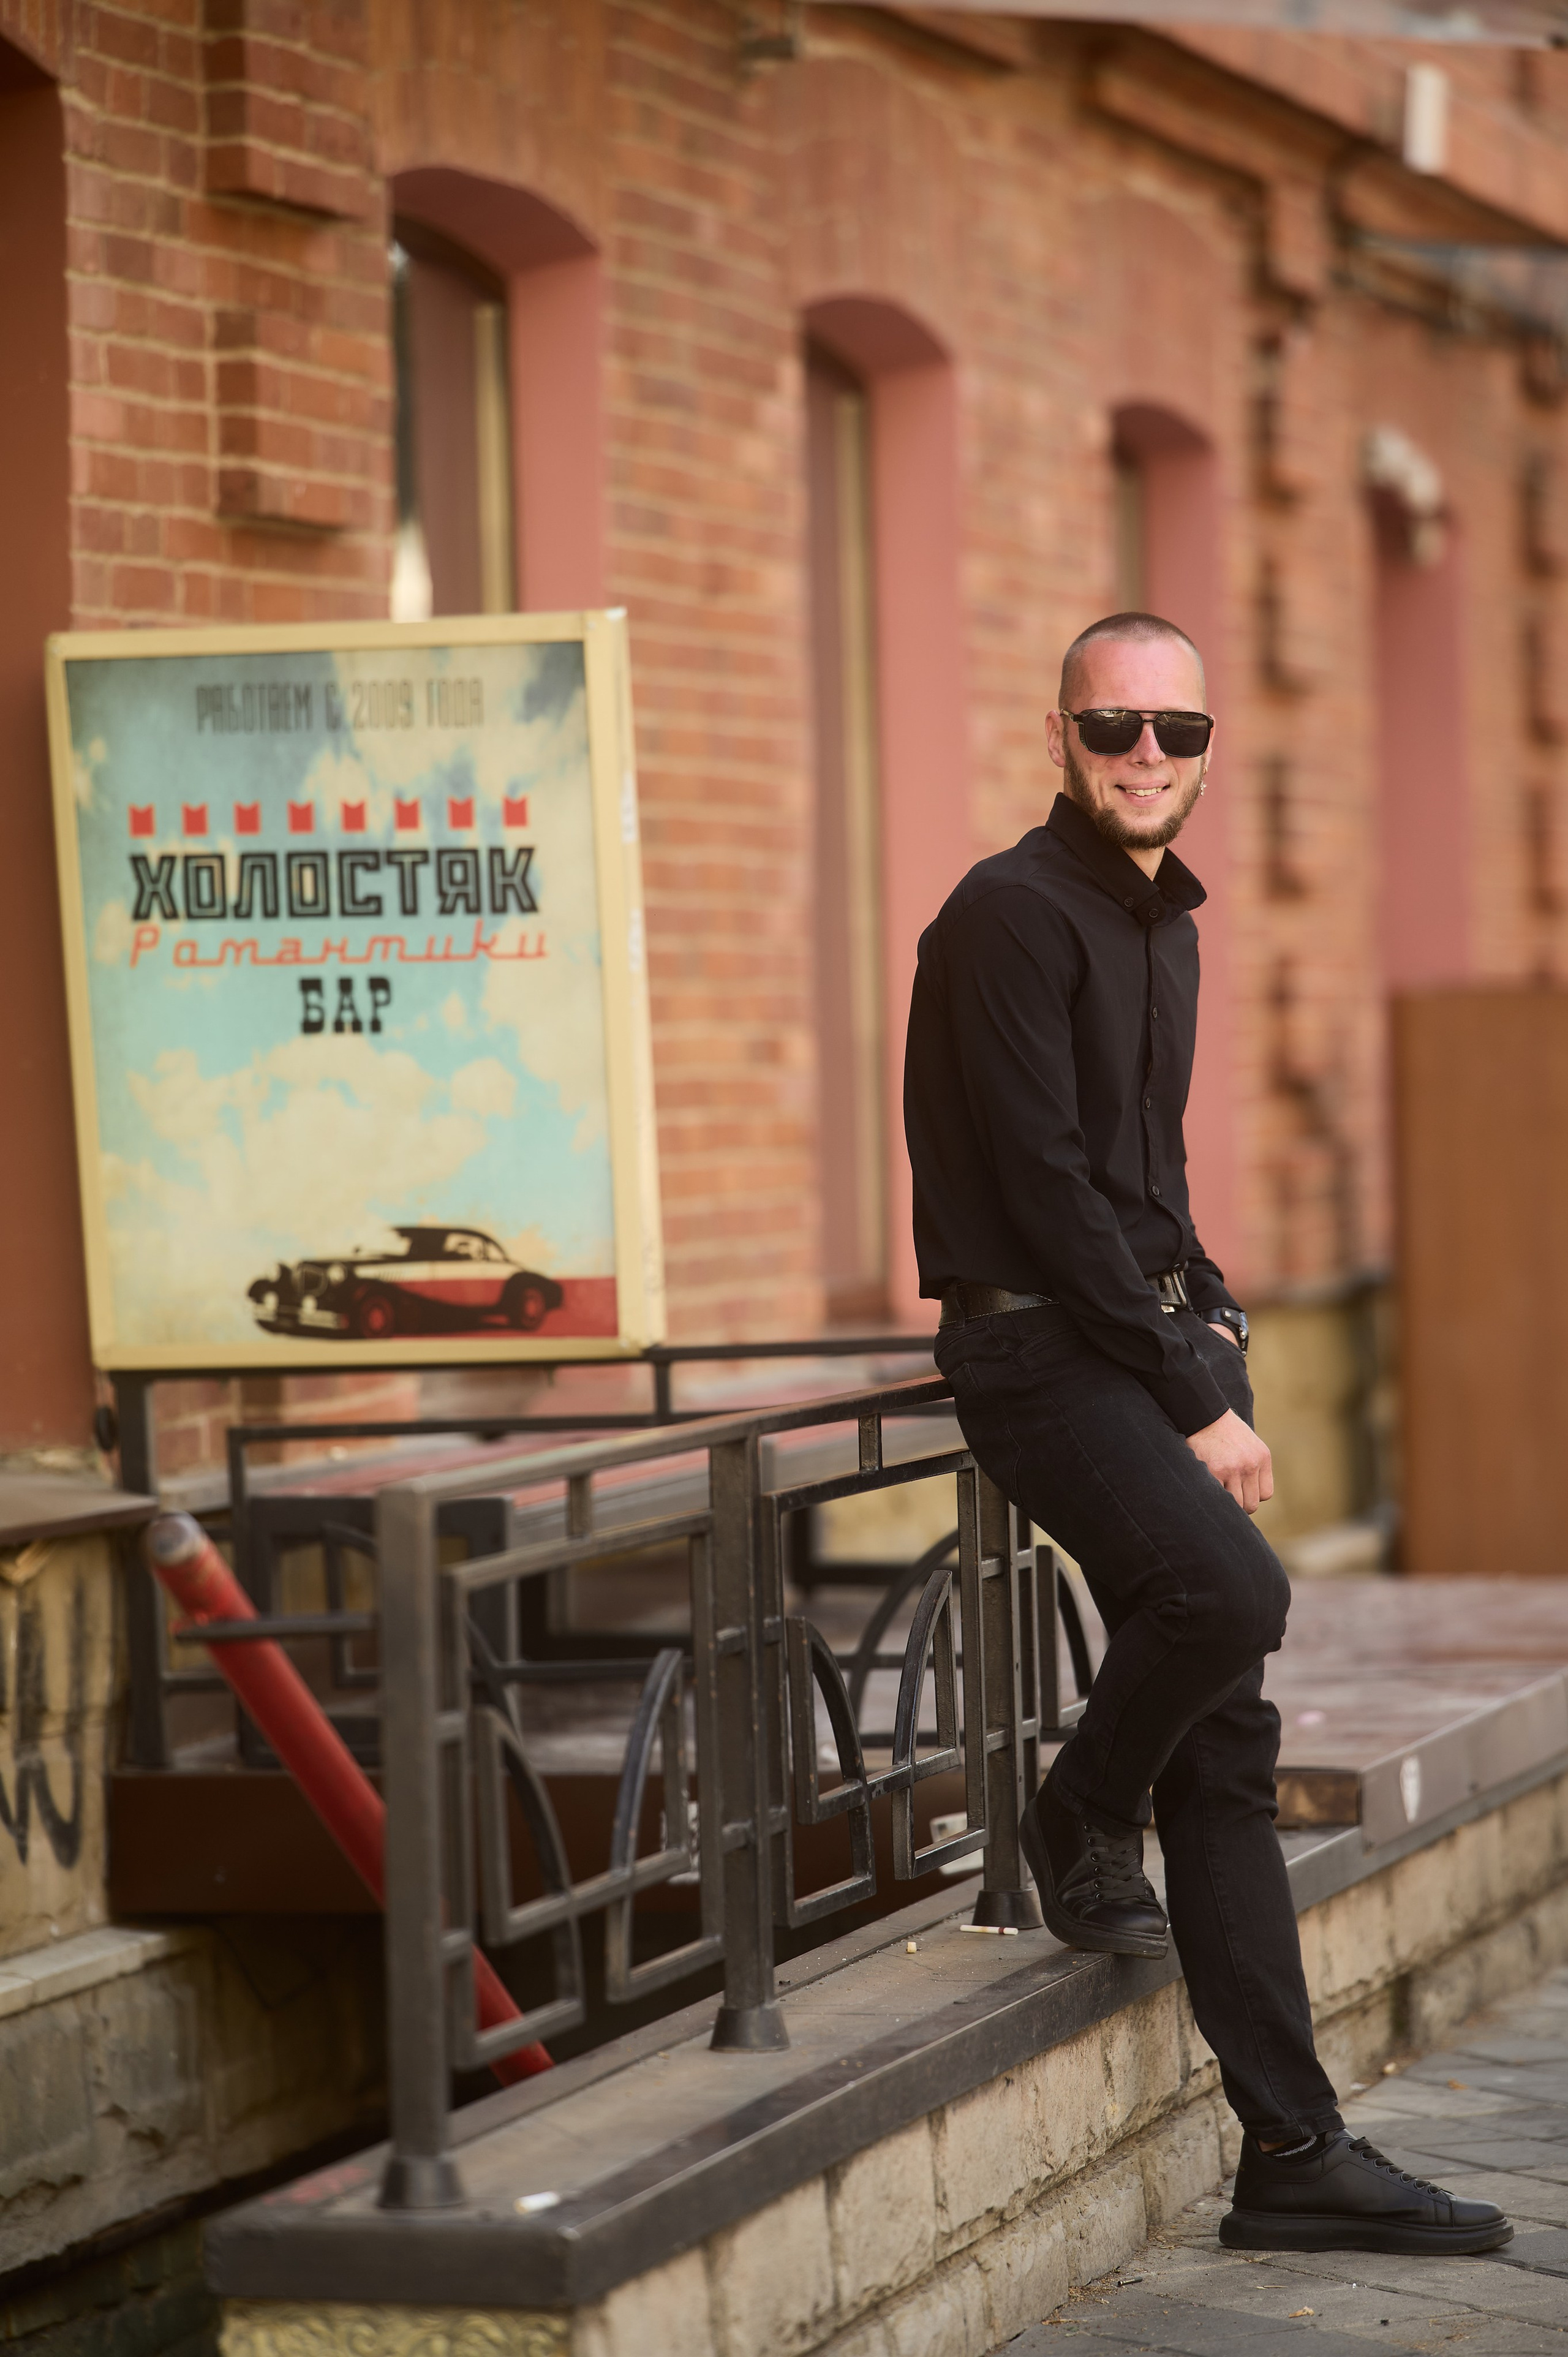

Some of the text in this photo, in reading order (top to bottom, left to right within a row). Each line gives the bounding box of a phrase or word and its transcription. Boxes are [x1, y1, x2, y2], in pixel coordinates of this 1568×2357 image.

[352, 678, 413, 731] 2009
[129, 847, 538, 921] ХОЛОСТЯК
[130, 919, 548, 968] Романтики
[299, 977, 392, 1035] БАР
